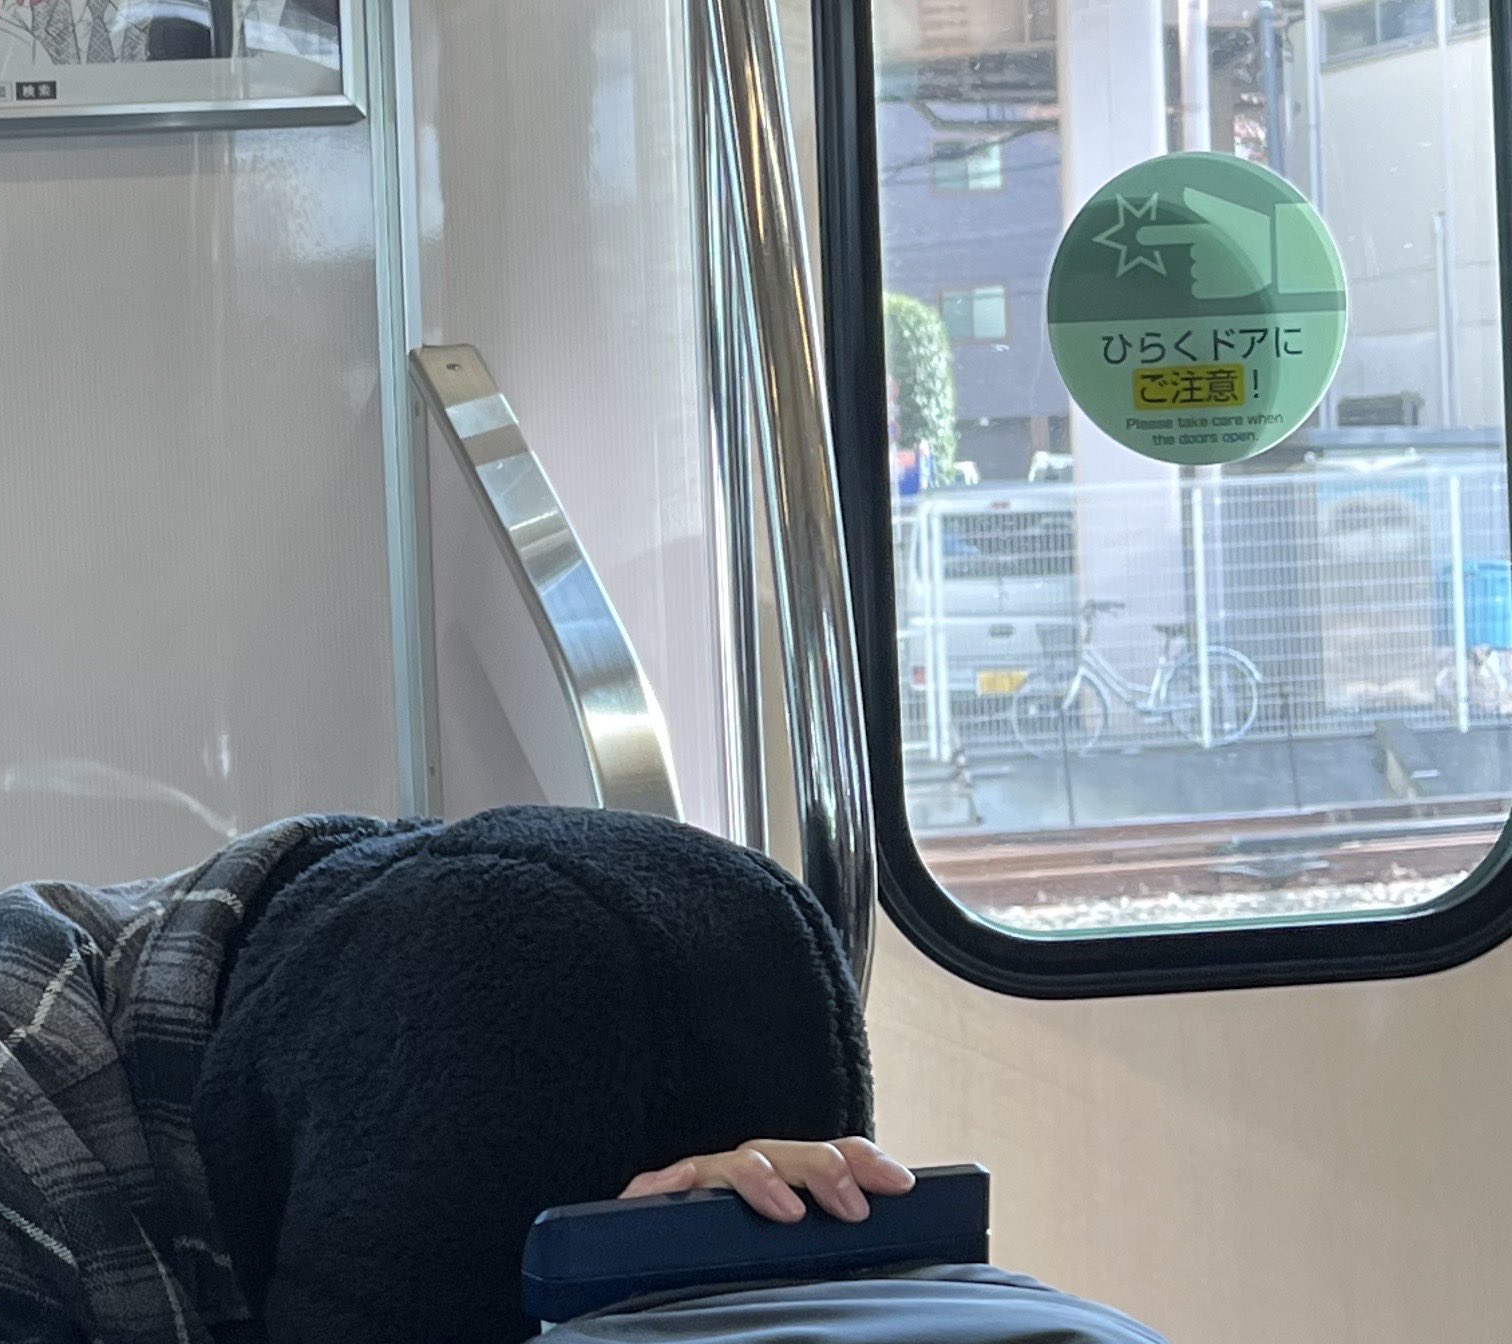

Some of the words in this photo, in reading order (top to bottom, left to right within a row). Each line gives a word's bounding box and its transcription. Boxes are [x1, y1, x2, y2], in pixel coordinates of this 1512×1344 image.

[1101, 326, 1303, 365] ひらくドアに
[1140, 368, 1260, 404] ご注意!
[1126, 417, 1173, 430] Please
[1177, 415, 1209, 428] take
[1211, 415, 1243, 427] care
[1247, 412, 1284, 425] when
[1152, 433, 1172, 446] the
[1178, 432, 1218, 444] doors
